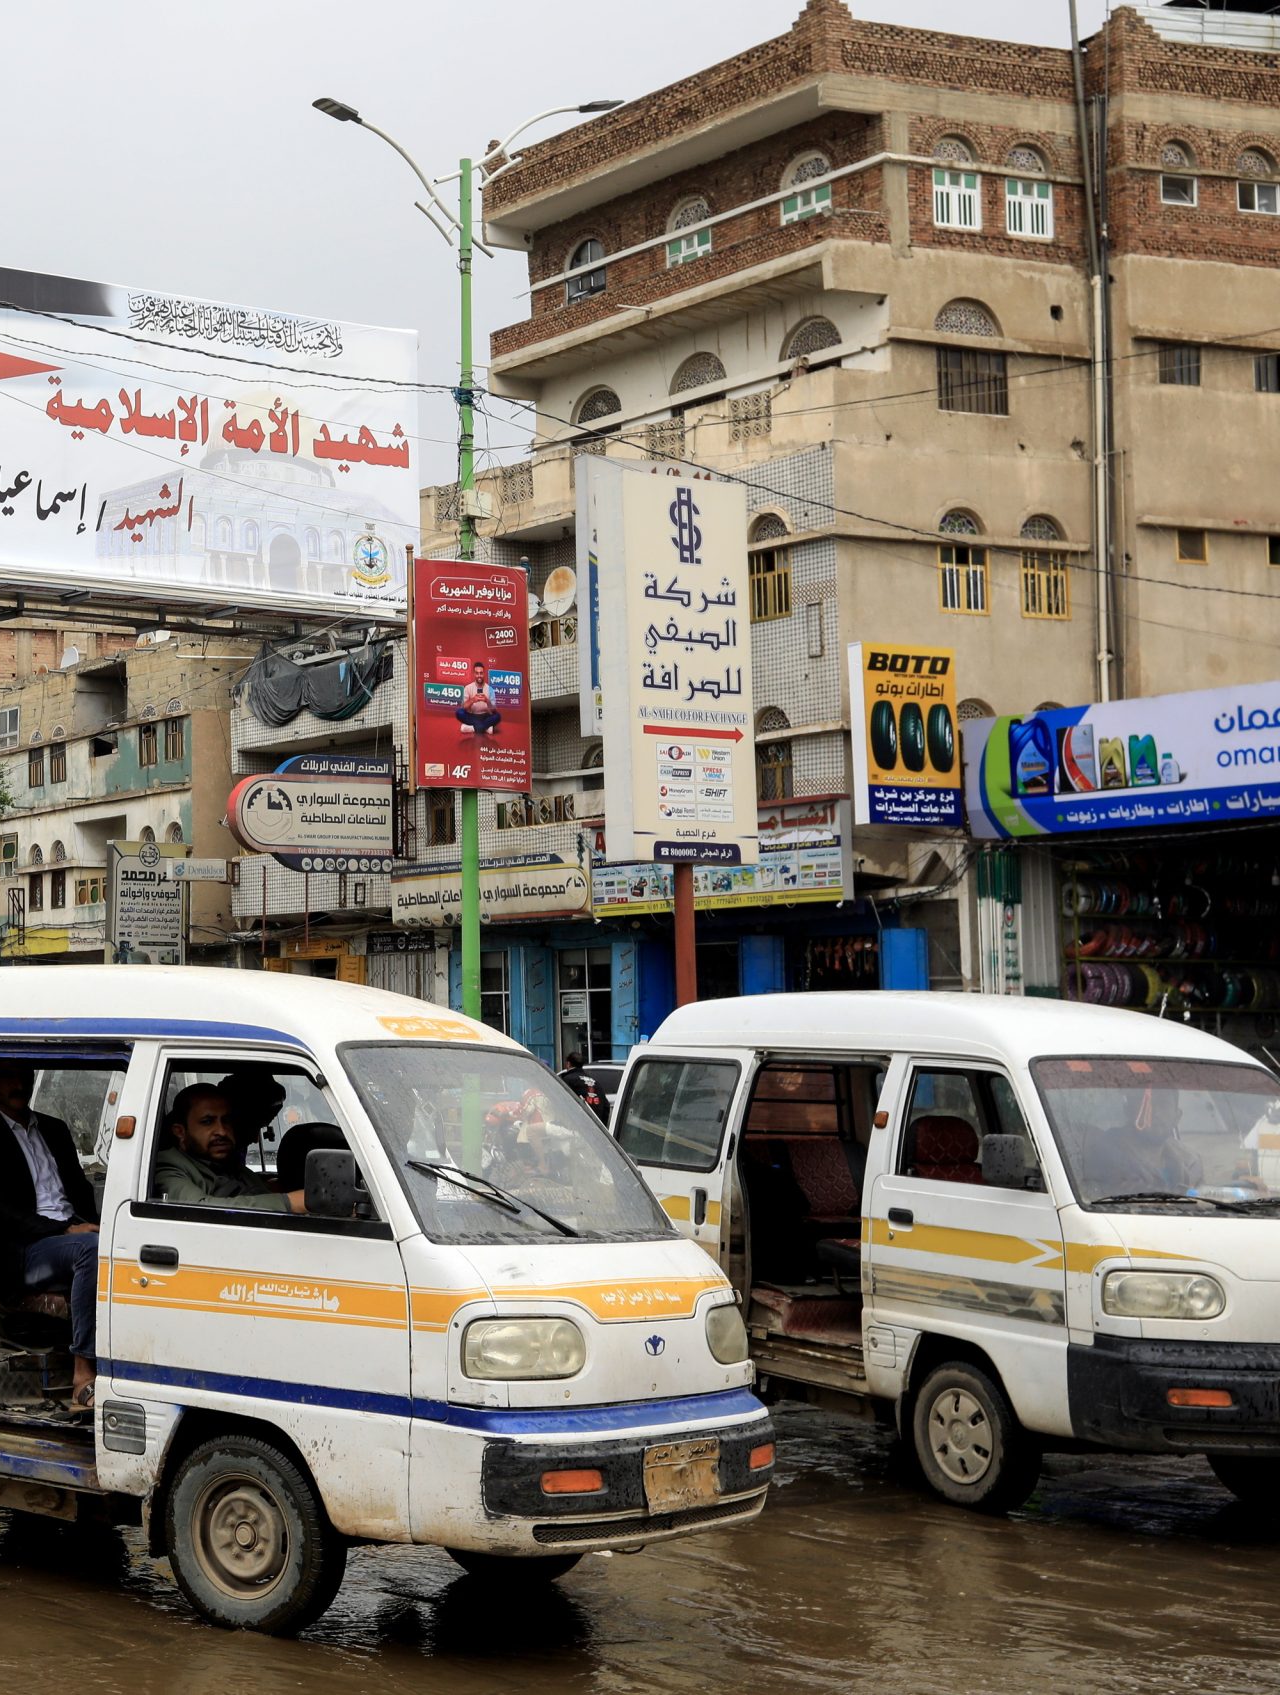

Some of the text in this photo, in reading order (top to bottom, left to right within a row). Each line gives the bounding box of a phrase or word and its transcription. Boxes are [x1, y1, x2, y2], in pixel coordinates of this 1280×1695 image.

[46, 376, 410, 473] شهيد الأمة الإسلامية
[113, 477, 194, 543] الشهيد
[439, 583, 512, 601] مزايا توفير الشهرية
[644, 572, 737, 614] شركة
[495, 630, 513, 639] 2400
[645, 616, 737, 655] الصيفي
[451, 661, 468, 670] 450
[867, 652, 950, 675] BOTO
[504, 675, 520, 685] 4GB
[642, 662, 742, 701] للصرافة
[441, 687, 461, 698] 450
[876, 680, 945, 700] إطارات بوتو
[1217, 745, 1280, 768] oma
[301, 760, 389, 774] المصنع الفني للربلات
[452, 765, 471, 779] 4G
[296, 792, 390, 809] مجموعة السواري
[875, 788, 954, 802] فرع مركز بن شرف
[875, 802, 955, 814] لخدمات السيارات
[1067, 797, 1210, 823] إطارات بطاريات زيوت
[300, 812, 386, 825] للصناعات المطاطية
[676, 828, 716, 840] فرع الحصبة
[526, 854, 550, 864] المصنع
[670, 848, 733, 859] الرقم المجاني 8000002
[121, 870, 156, 882] محمد
[188, 865, 225, 875] Donaldson
[150, 888, 180, 901] الجوفي
[398, 883, 566, 907] مجموعة السواري المطاطية
[219, 1283, 248, 1302] الله
[259, 1282, 310, 1297] تبارك الله
